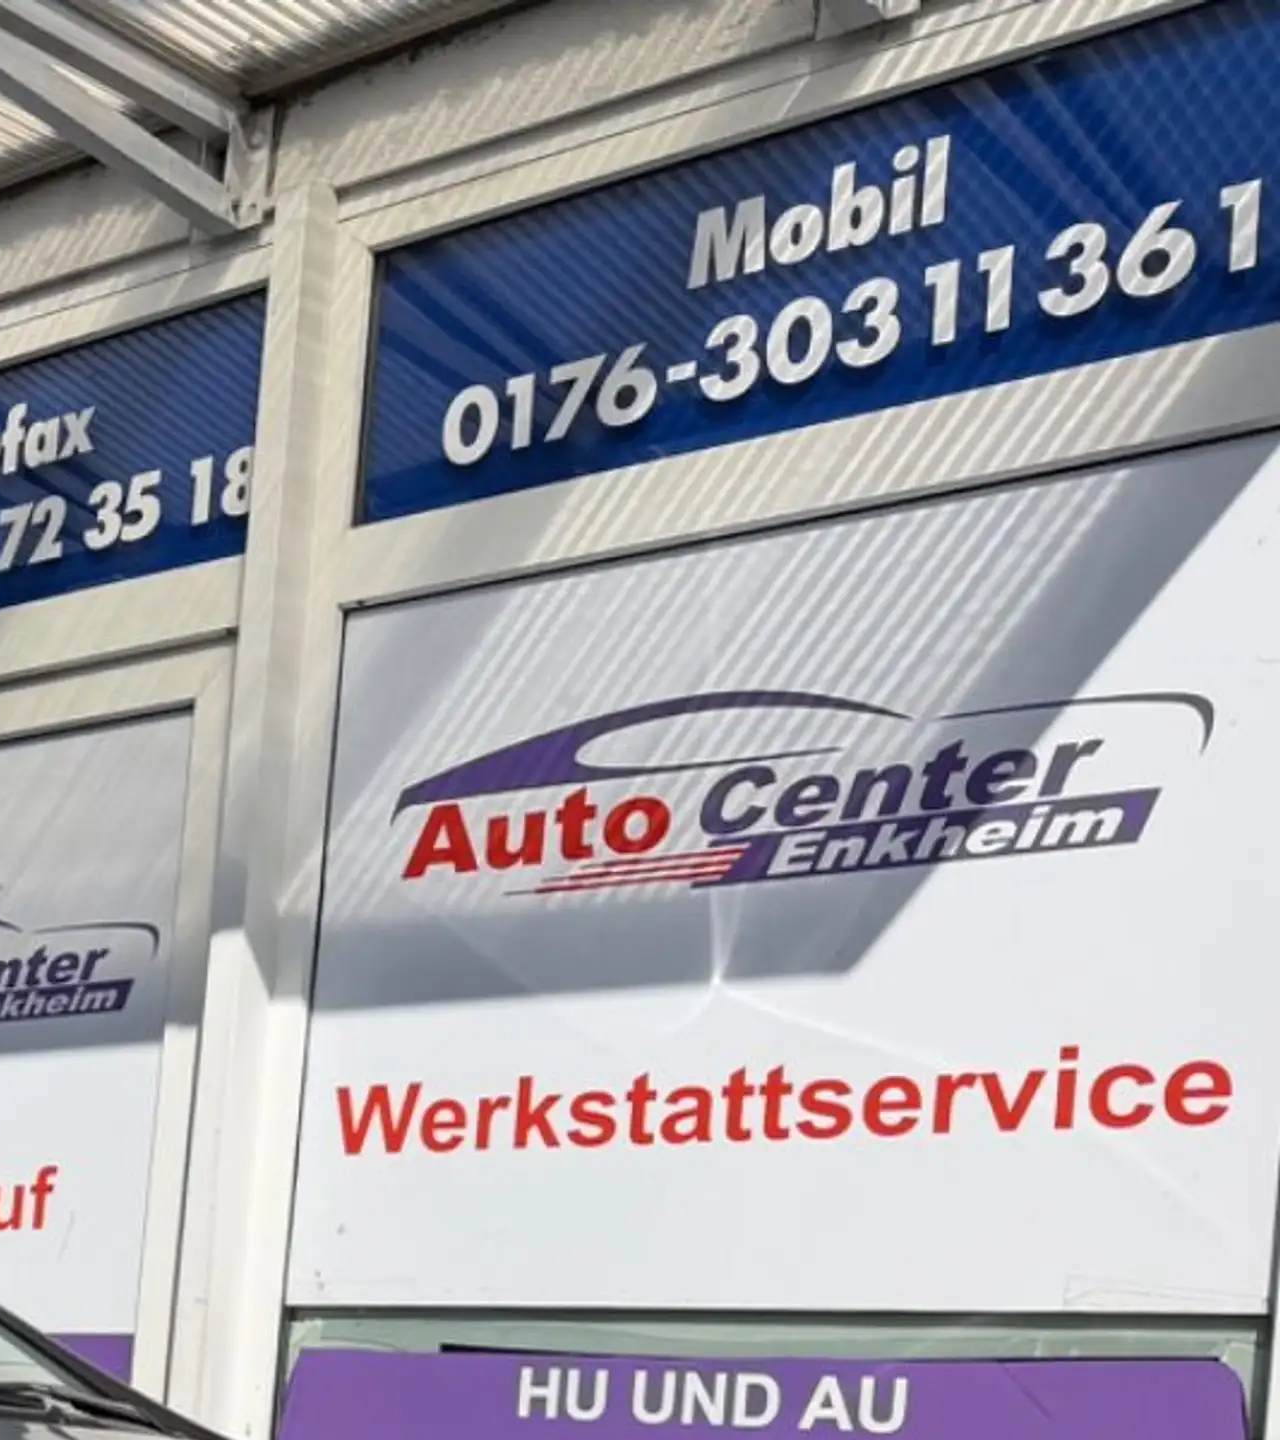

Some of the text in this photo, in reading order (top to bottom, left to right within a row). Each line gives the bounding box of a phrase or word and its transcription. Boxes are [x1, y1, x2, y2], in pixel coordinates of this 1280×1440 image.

[687, 134, 951, 289] Mobil
[83, 470, 163, 552] 35
[190, 446, 254, 526] 18
[401, 737, 1105, 881] Auto Center
[766, 797, 1126, 877] Enkheim
[335, 1044, 1235, 1156] Werkstattservice
[516, 1367, 909, 1435] HU UND AU
